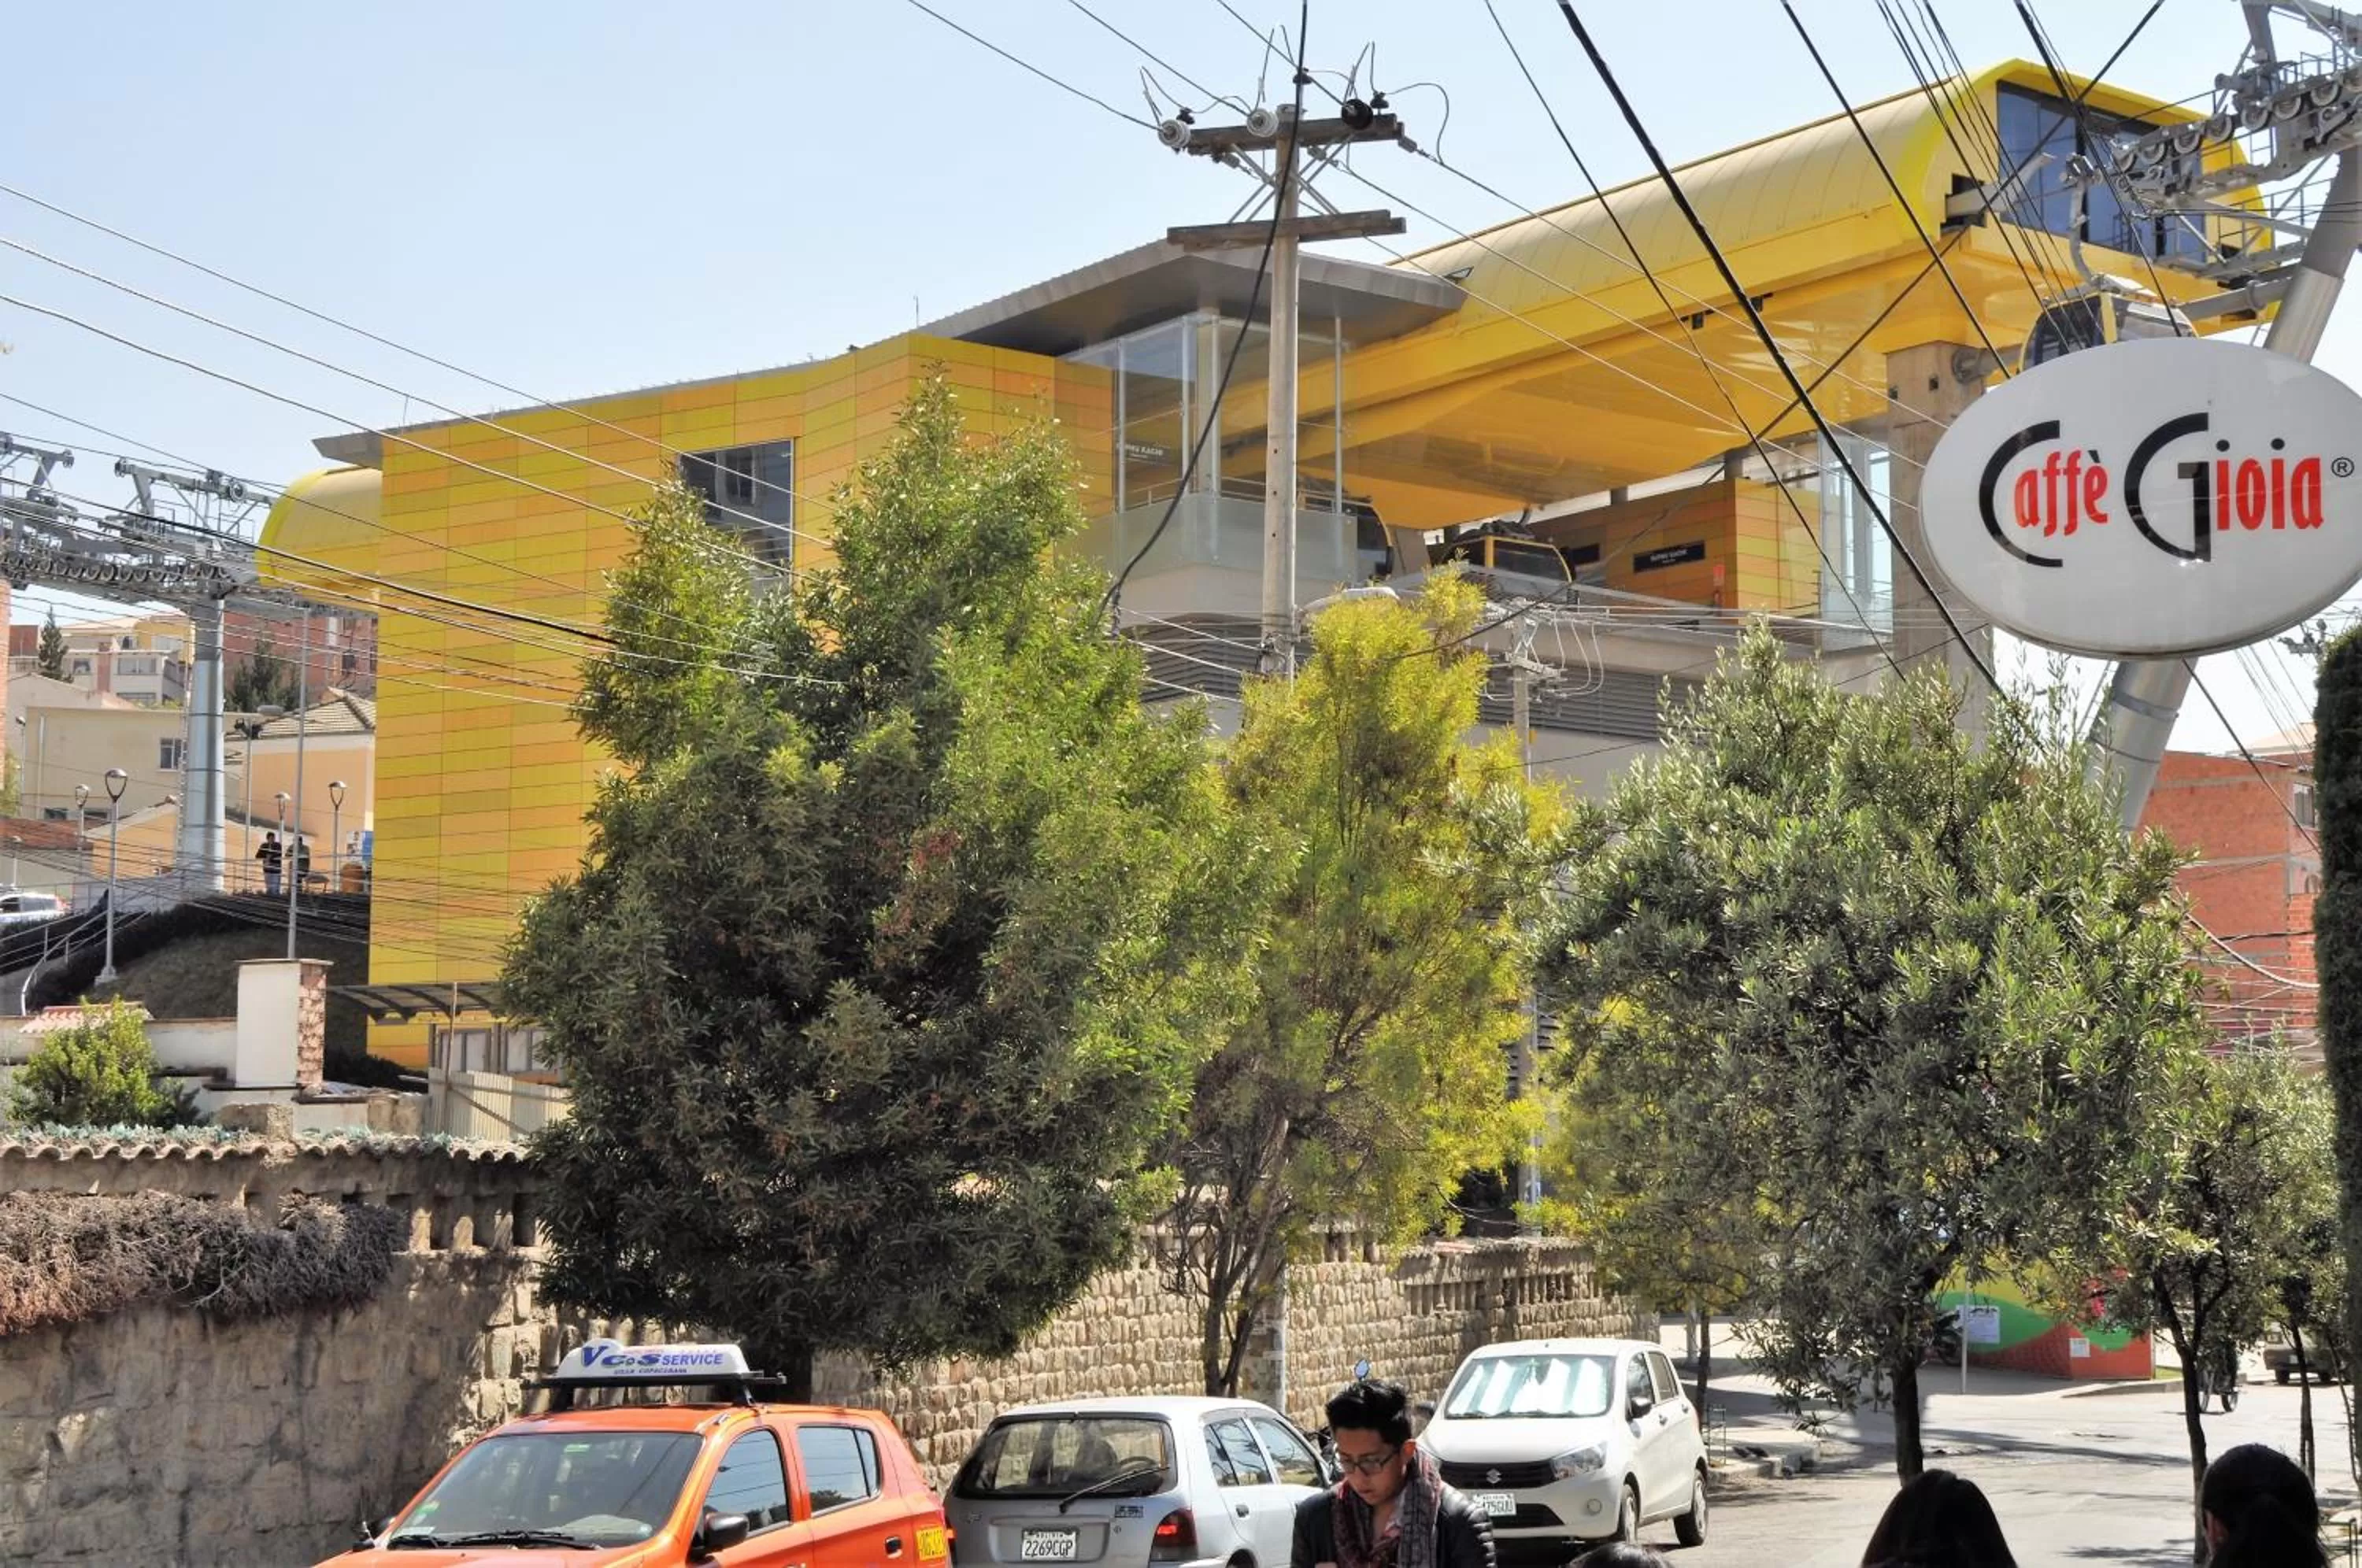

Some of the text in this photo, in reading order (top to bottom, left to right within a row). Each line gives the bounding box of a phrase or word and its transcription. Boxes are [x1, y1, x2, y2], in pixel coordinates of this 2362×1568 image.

[1979, 412, 2324, 568] Caffè Gioia
[661, 1353, 724, 1366] SERVICE
[1024, 1540, 1073, 1557] 2269CGP
